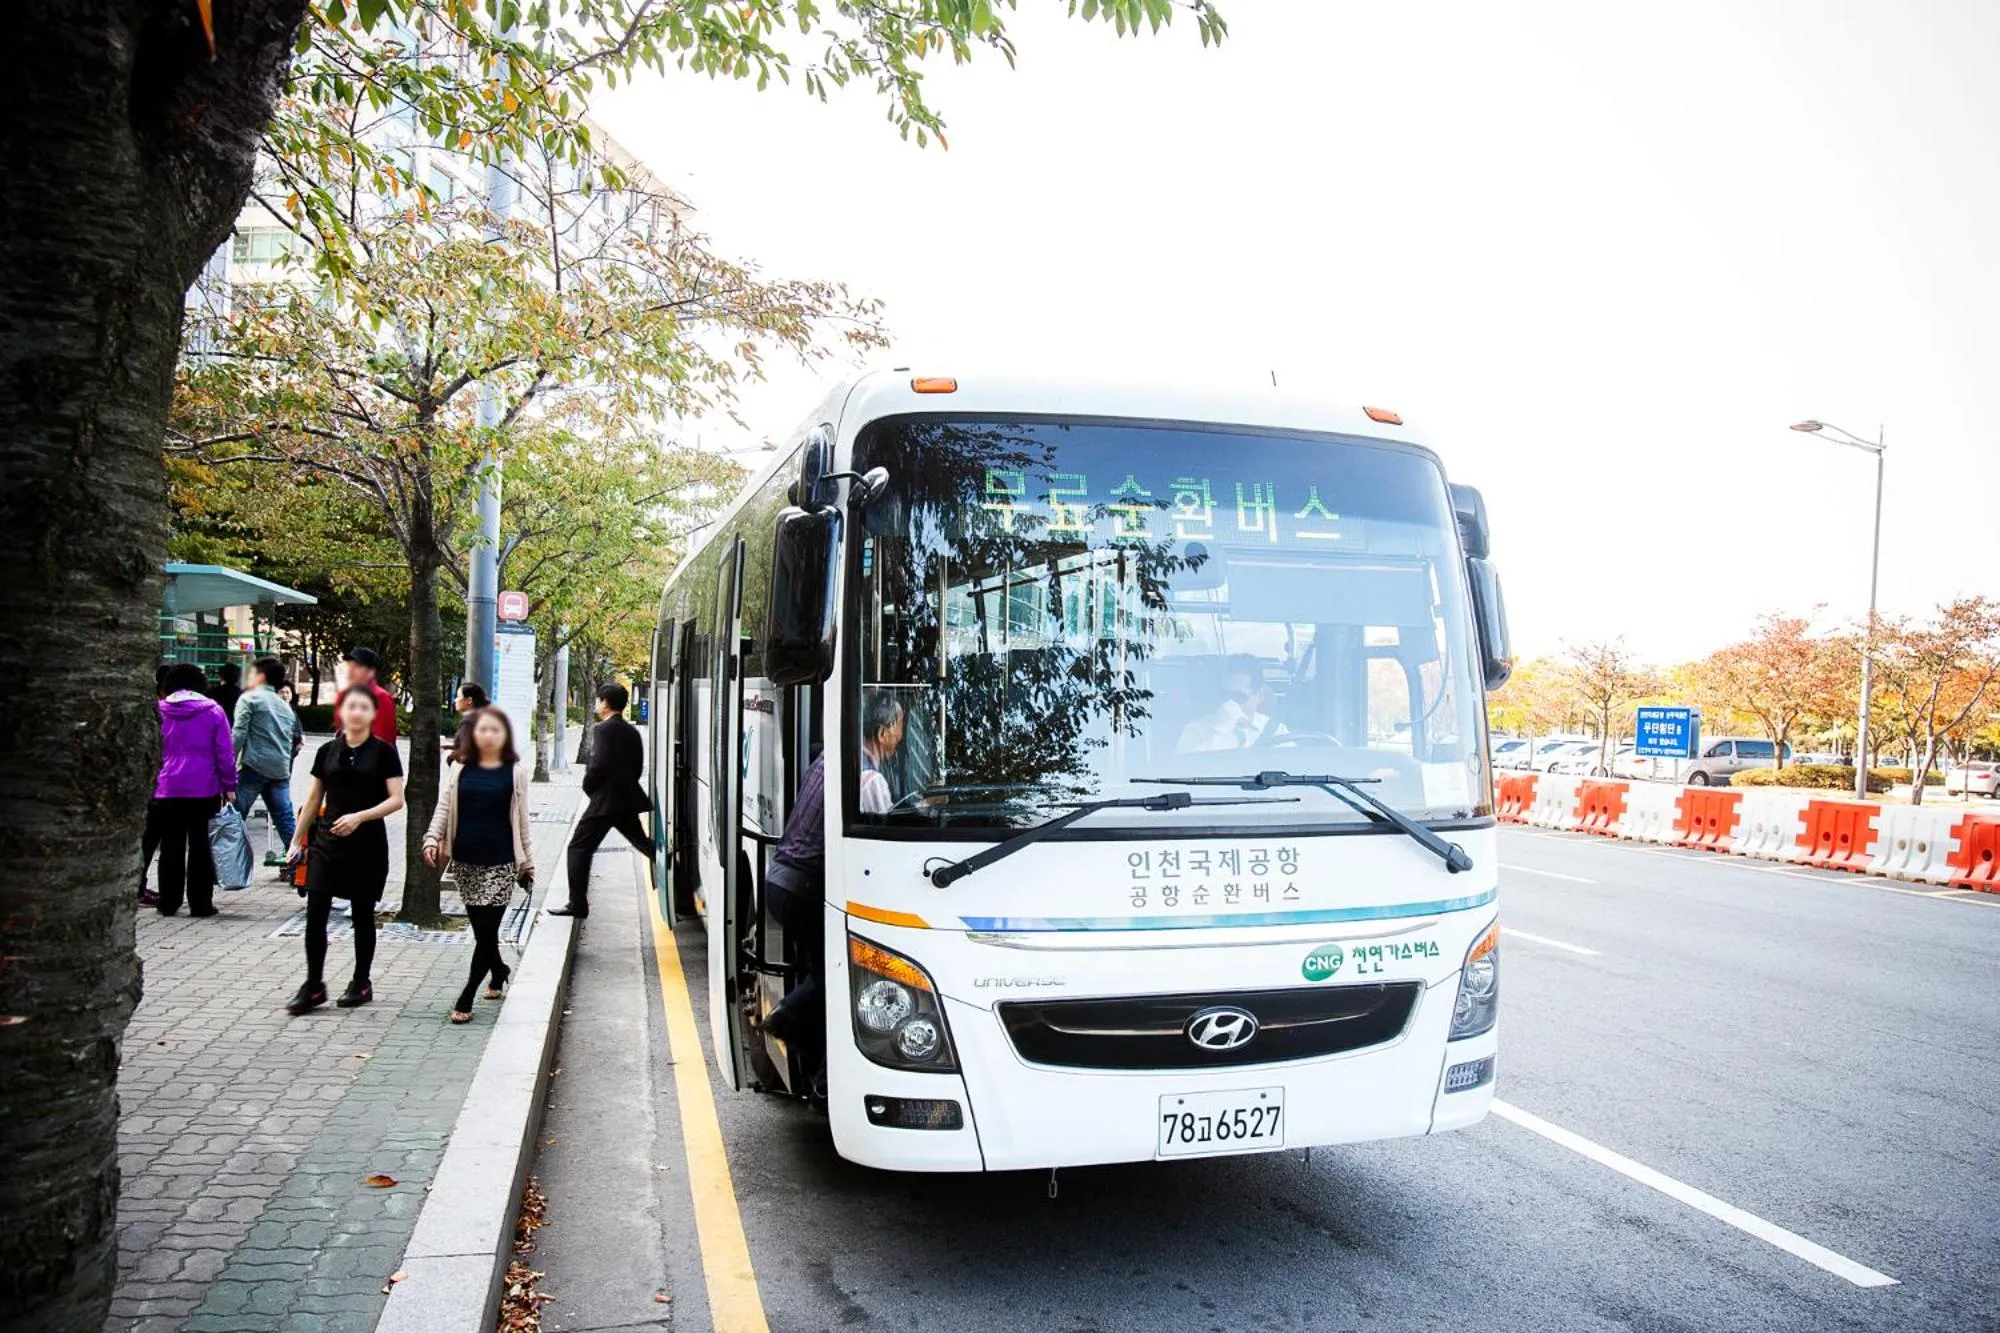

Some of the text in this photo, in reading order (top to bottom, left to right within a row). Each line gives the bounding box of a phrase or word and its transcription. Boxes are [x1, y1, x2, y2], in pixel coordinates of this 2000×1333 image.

[983, 470, 1340, 543] 무료순환버스
[1127, 847, 1300, 879] 인천국제공항
[1129, 881, 1300, 908] 공항순환버스
[1305, 955, 1341, 970] CNG
[1352, 941, 1440, 974] 천연가스버스
[1163, 1106, 1280, 1144] 78고6527
